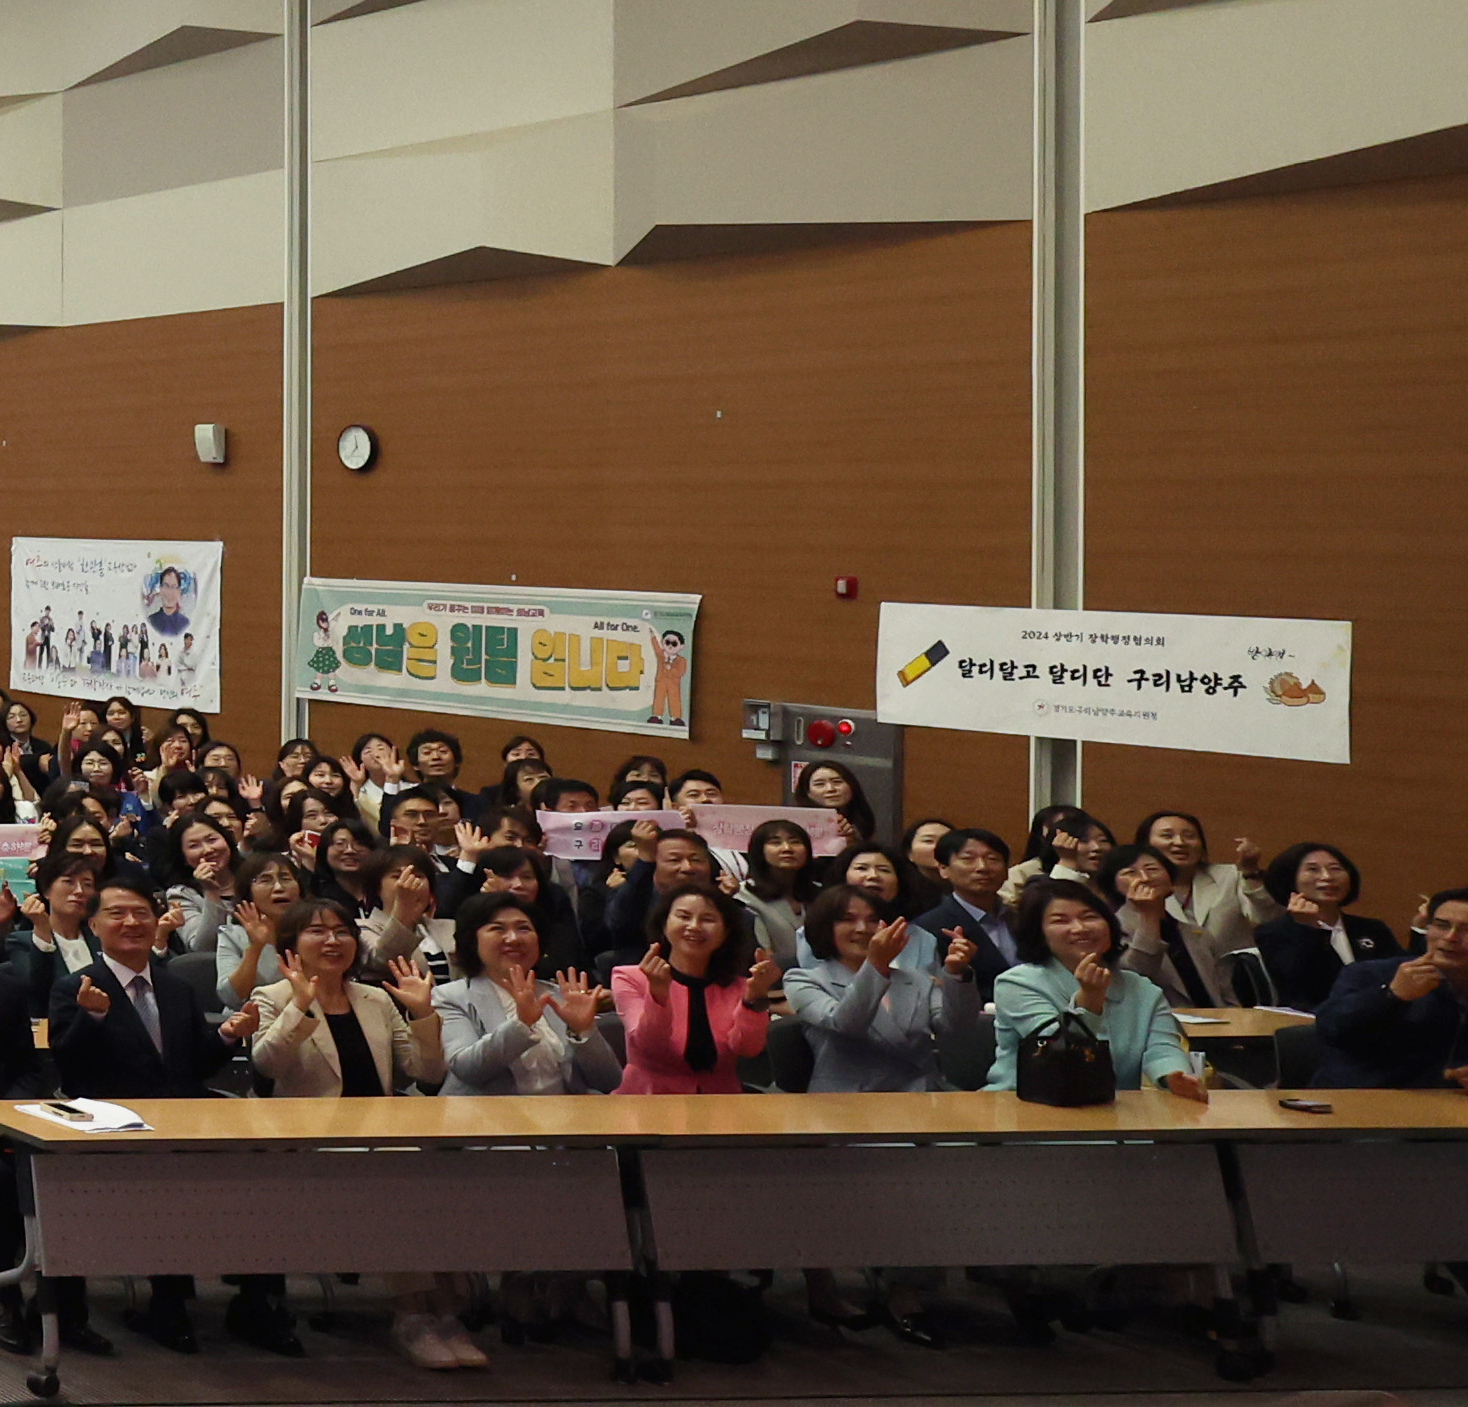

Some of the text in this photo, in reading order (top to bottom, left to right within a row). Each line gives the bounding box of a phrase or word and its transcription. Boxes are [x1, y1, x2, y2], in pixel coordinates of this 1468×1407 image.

[342, 620, 644, 692] 성남은 원팀 입니다
[1021, 630, 1049, 640] 2024
[1052, 631, 1084, 643] 상반기
[957, 657, 1247, 698] 달디달고 달디단 구리남양주
